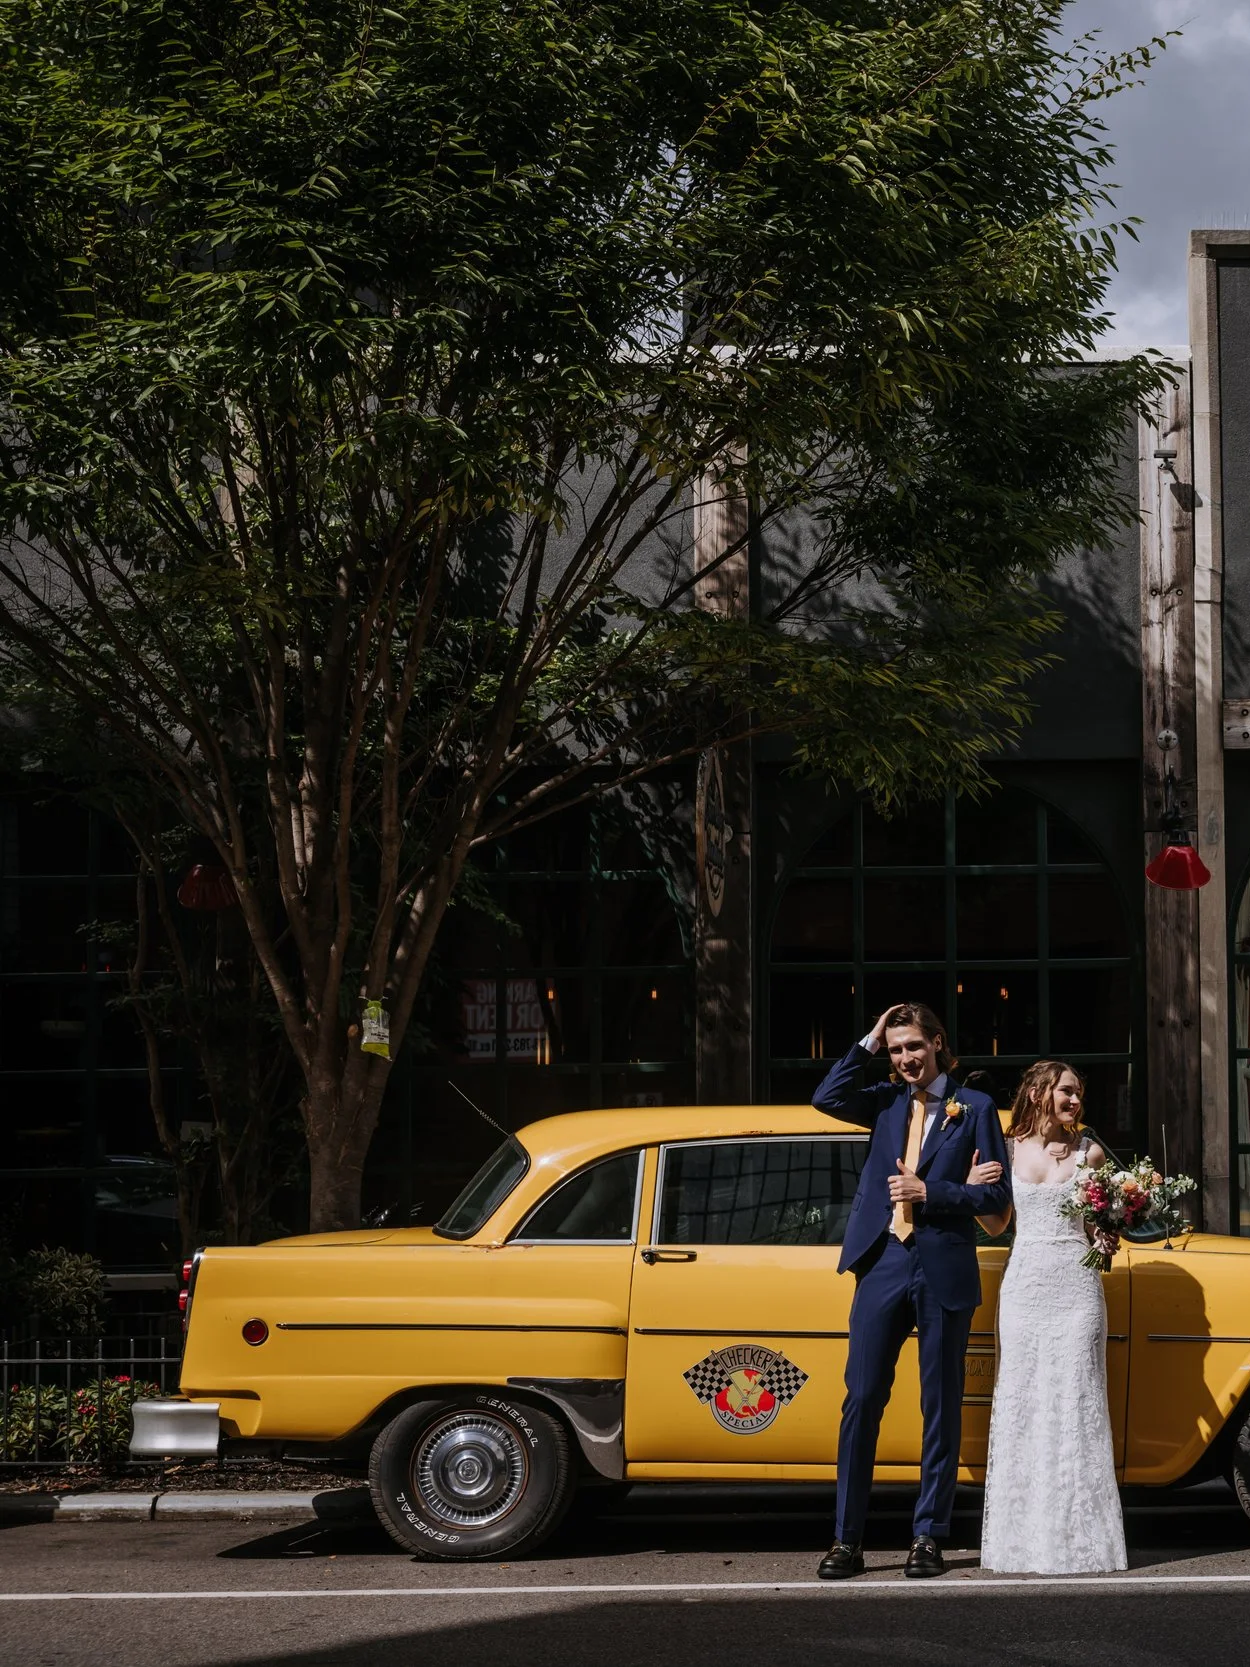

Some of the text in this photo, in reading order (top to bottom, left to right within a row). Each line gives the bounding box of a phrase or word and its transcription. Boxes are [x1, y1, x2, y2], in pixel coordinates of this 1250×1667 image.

[720, 1348, 773, 1369] CHECKER
[476, 1395, 539, 1448] GENERAL
[721, 1411, 768, 1428] SPECIAL
[396, 1492, 460, 1544] GENERAL
